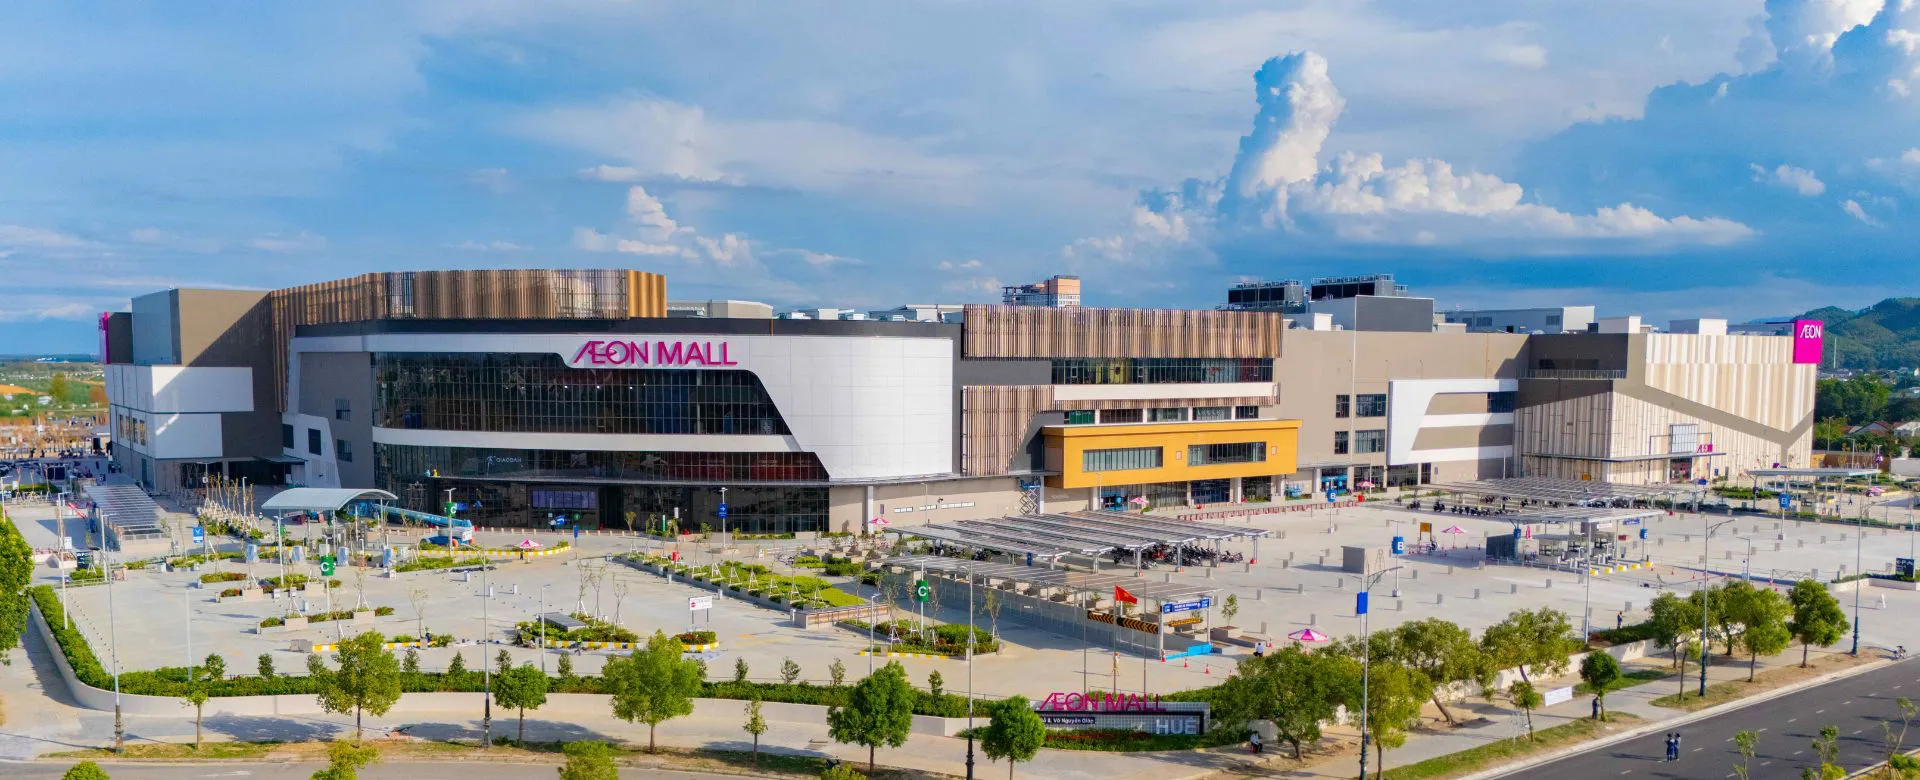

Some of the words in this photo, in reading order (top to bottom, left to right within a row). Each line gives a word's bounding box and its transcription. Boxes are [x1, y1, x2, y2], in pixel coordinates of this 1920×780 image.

[657, 341, 738, 366] MALL
[450, 506, 457, 514] C
[320, 562, 330, 571] C
[917, 585, 928, 597] C
[1105, 693, 1167, 712] MALL
